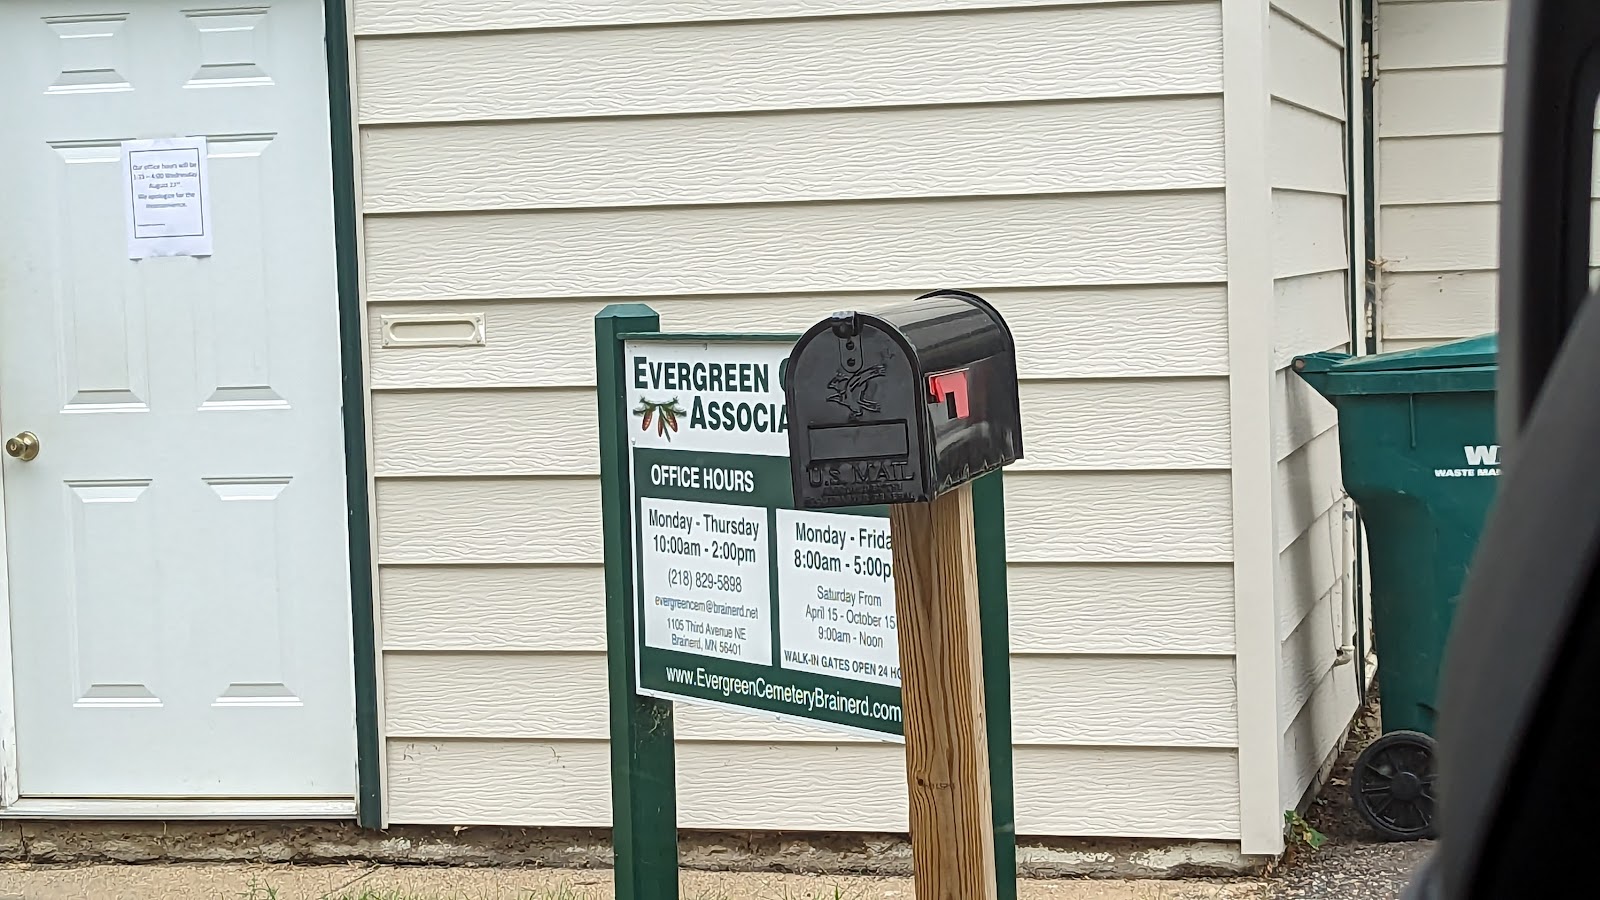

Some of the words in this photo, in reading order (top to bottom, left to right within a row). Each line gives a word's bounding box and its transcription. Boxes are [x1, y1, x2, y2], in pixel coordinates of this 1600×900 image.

[633, 356, 769, 393] EVERGREEN
[690, 396, 789, 433] ASSOCIA
[1464, 445, 1502, 465] W
[651, 464, 700, 488] OFFICE
[704, 468, 754, 493] HOURS
[852, 461, 915, 483] MAIL
[1434, 469, 1474, 477] WASTE
[649, 509, 692, 534] Monday
[703, 514, 759, 541] Thursday
[796, 522, 846, 550] Monday
[859, 528, 892, 549] Frida
[653, 534, 700, 556] 10:00am
[712, 541, 756, 566] 2:00pm
[795, 549, 841, 572] 8:00am
[854, 556, 891, 582] 5:00p
[668, 568, 692, 590] (218)
[696, 572, 742, 592] 829-5898
[655, 595, 759, 619] evergreencem@brainerd.net
[817, 585, 856, 606] Saturday
[859, 591, 882, 607] From
[667, 618, 684, 631] 1105
[685, 620, 704, 634] Third
[706, 623, 732, 637] Avenue
[735, 628, 746, 640] NE
[806, 604, 825, 622] April
[828, 608, 838, 621] 15
[847, 609, 882, 627] October
[885, 616, 895, 629] 15
[672, 634, 703, 651] Brainerd,
[705, 638, 716, 652] MN
[720, 642, 741, 655] 56401
[818, 626, 851, 643] 9:00am
[859, 631, 883, 648] Noon
[784, 650, 819, 666] WALK-IN
[822, 656, 850, 671] GATES
[852, 661, 876, 675] OPEN
[878, 664, 888, 678] 24
[666, 667, 901, 722] www.EvergreenCemeteryBrainerd.com
